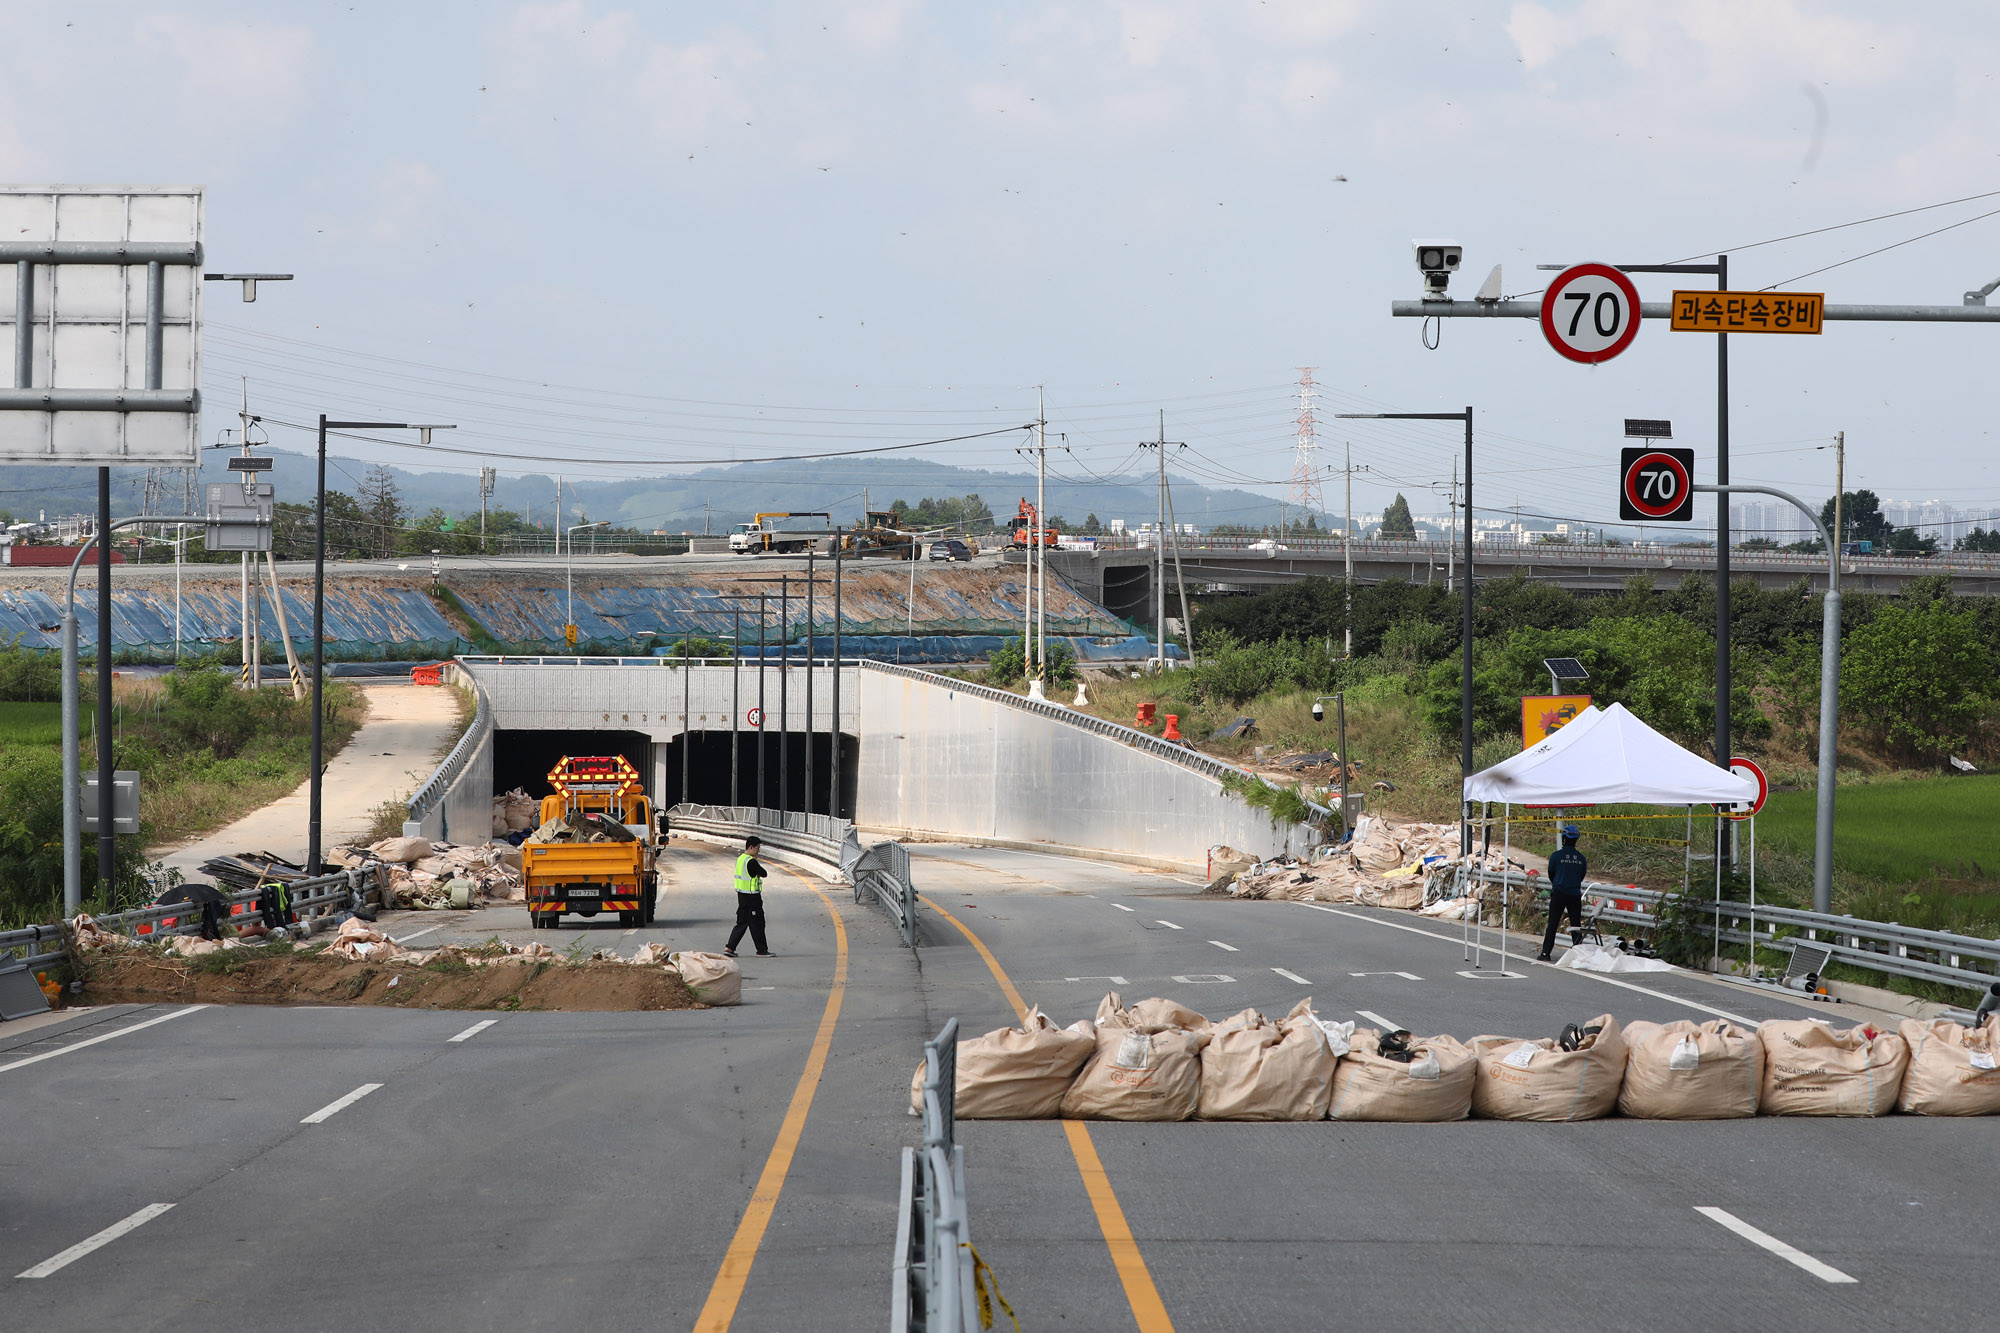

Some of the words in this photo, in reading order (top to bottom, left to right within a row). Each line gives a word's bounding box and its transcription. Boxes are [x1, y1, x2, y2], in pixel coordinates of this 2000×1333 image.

[1564, 292, 1621, 337] 70
[1678, 297, 1816, 328] 과속단속장비
[1640, 470, 1676, 500] 70
[1774, 1063, 1827, 1076] POLYCARBONATE
